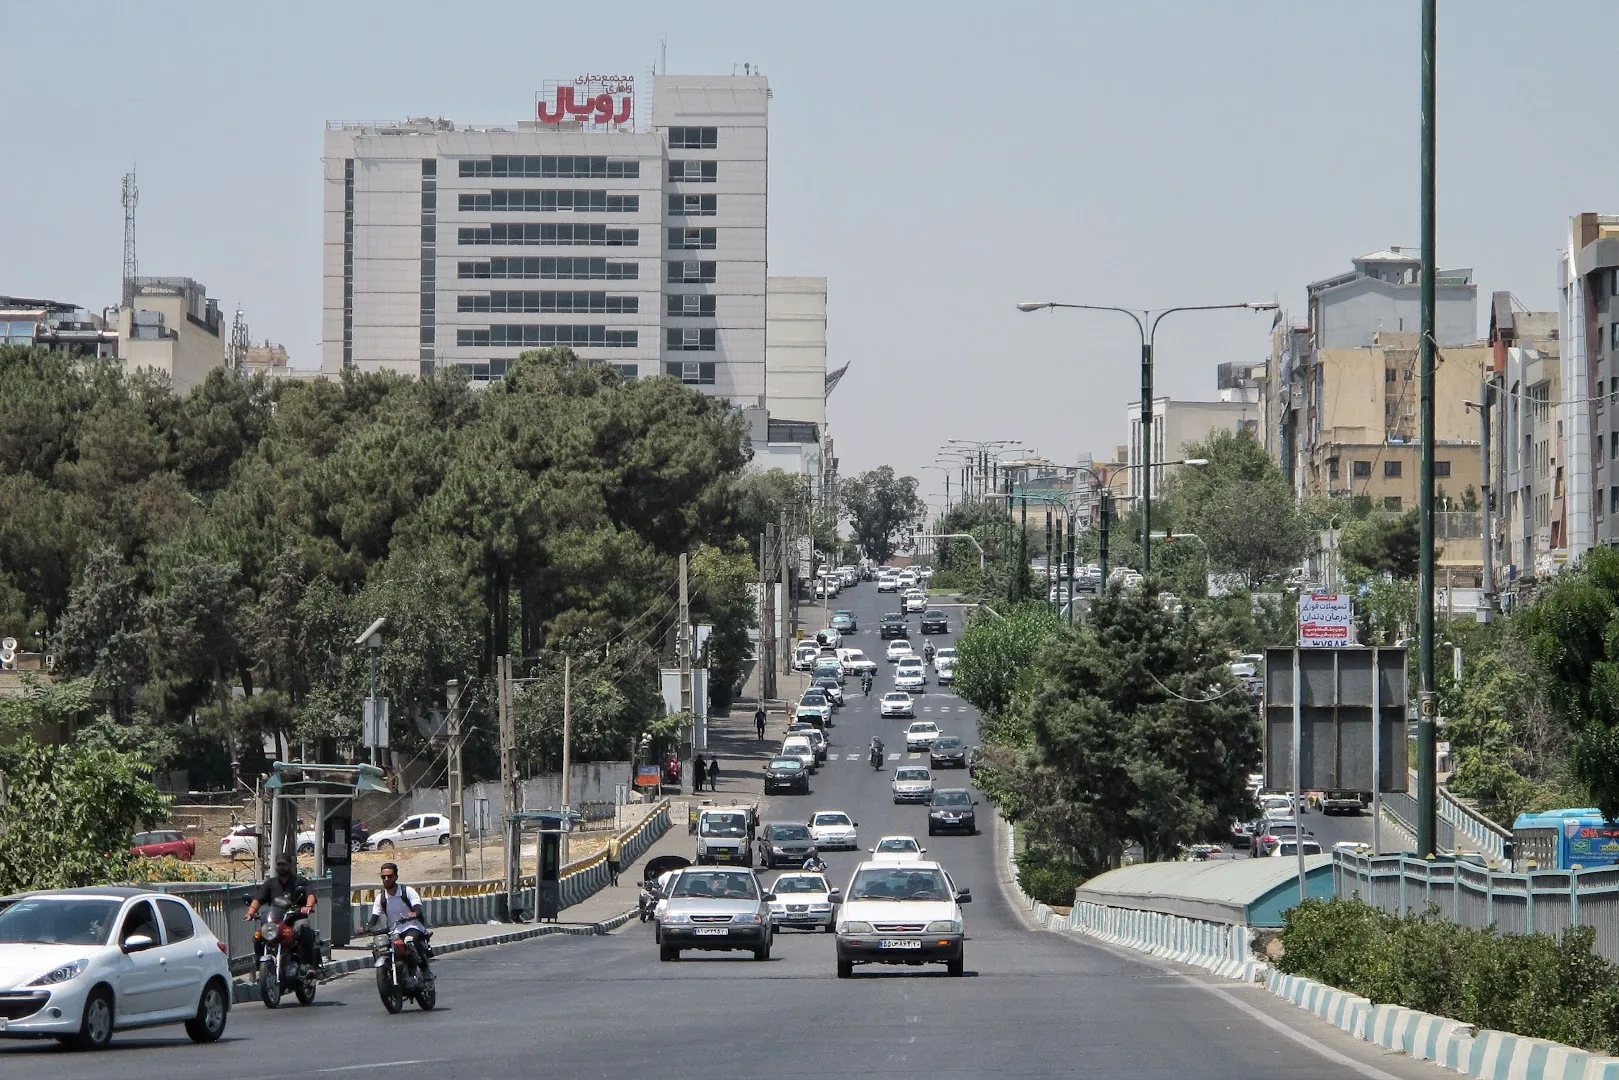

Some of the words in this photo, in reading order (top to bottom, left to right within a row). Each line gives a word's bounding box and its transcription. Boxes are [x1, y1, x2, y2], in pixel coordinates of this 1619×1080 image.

[575, 73, 601, 85] تجاری
[602, 74, 634, 86] مجتمع
[538, 86, 631, 124] رویال
[1303, 603, 1319, 611] فوری
[1320, 603, 1347, 611] تسهیلات
[1303, 613, 1324, 621] دندان
[1325, 613, 1347, 622] درمان
